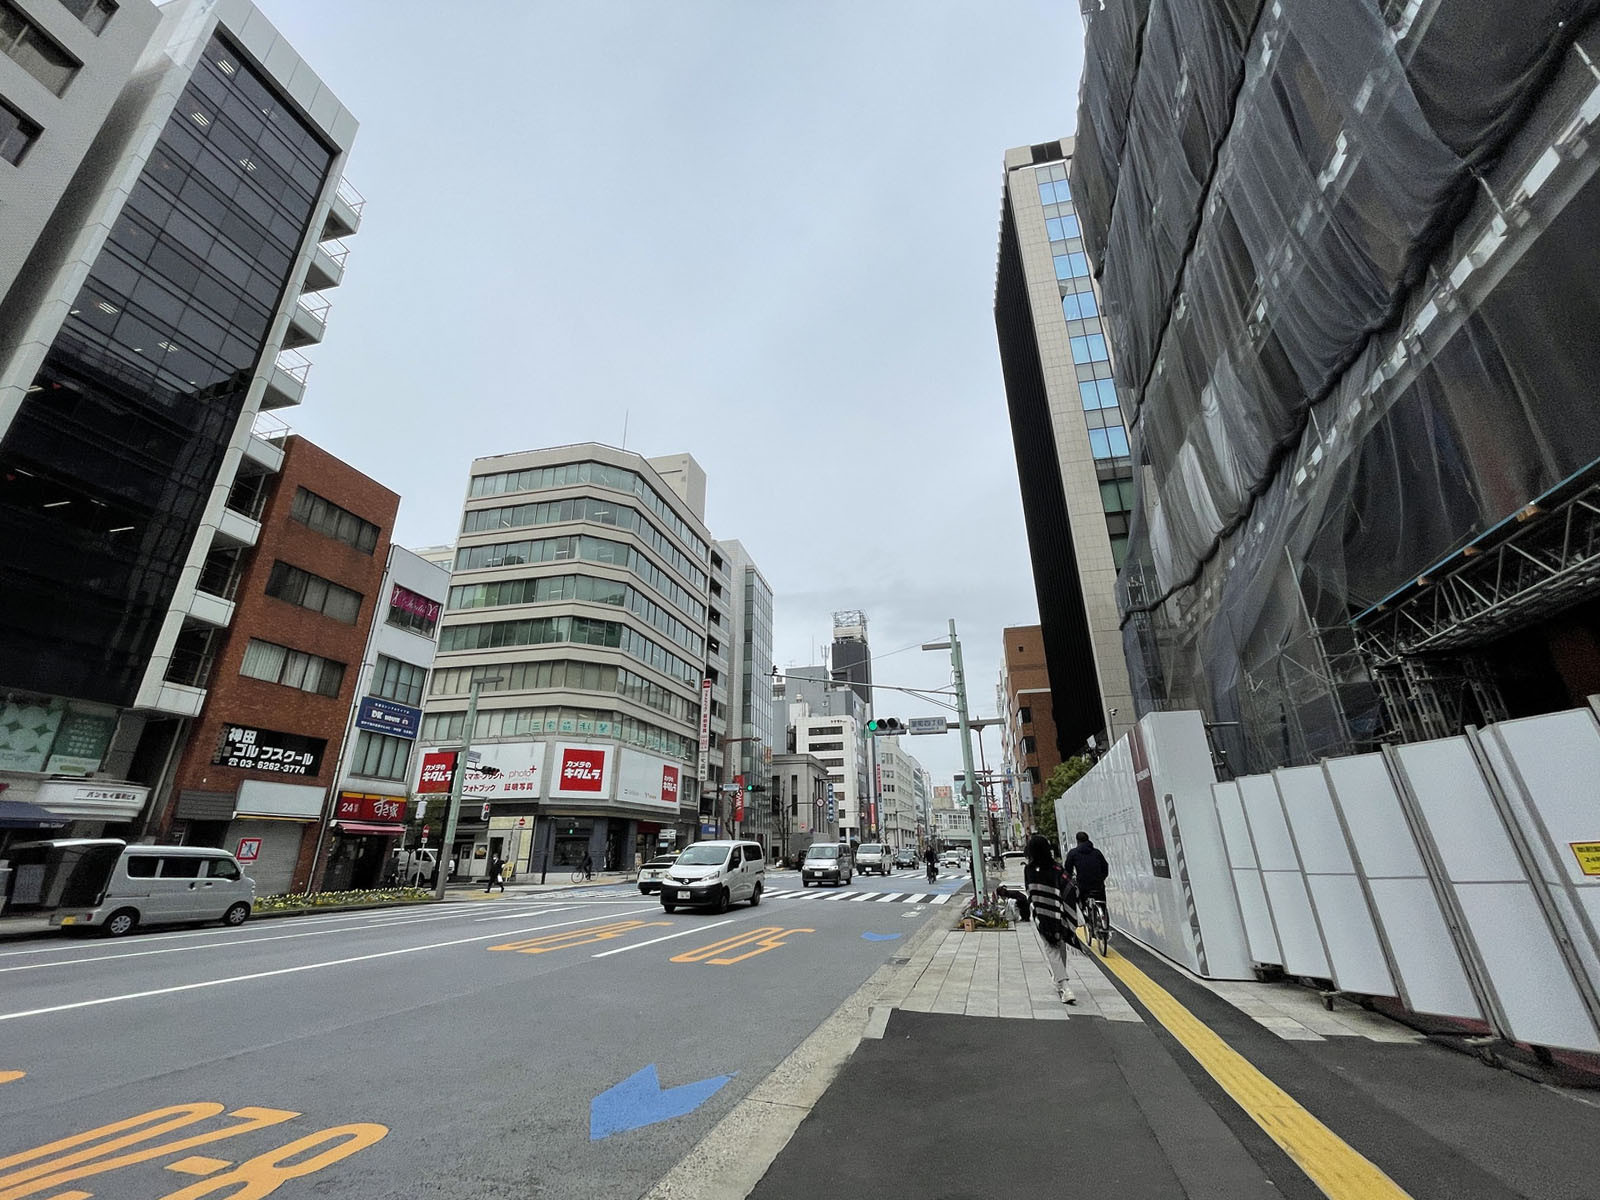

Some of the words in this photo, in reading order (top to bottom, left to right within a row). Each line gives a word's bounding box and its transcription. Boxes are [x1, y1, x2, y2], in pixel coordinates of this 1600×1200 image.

[228, 727, 257, 744] 神田
[233, 743, 314, 765] ゴルフスクール
[565, 760, 592, 768] カメラの
[422, 771, 453, 782] キタムラ
[563, 768, 600, 779] キタムラ
[504, 782, 534, 791] 証明写真
[373, 797, 400, 821] すき家
